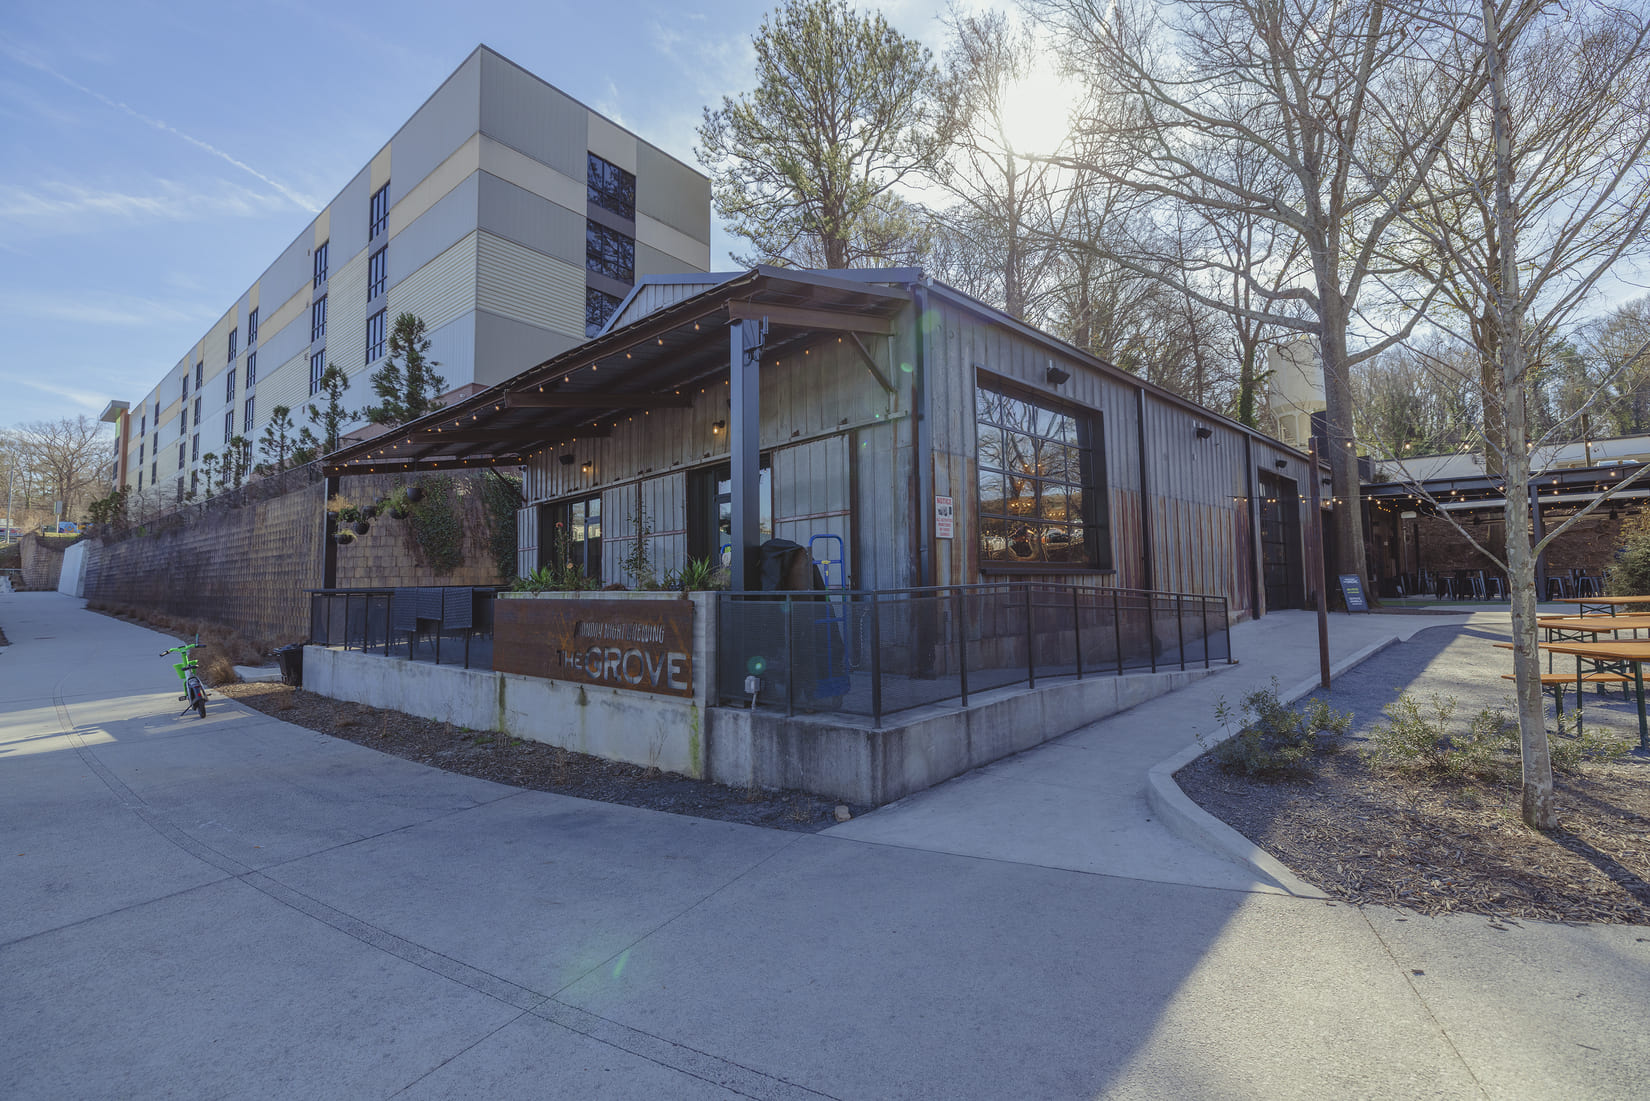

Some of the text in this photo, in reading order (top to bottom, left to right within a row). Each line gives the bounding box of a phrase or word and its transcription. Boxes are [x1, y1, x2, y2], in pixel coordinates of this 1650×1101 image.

[604, 623, 625, 641] NIGHT
[626, 623, 665, 644] BREWING
[556, 646, 688, 690] THE GROVE
